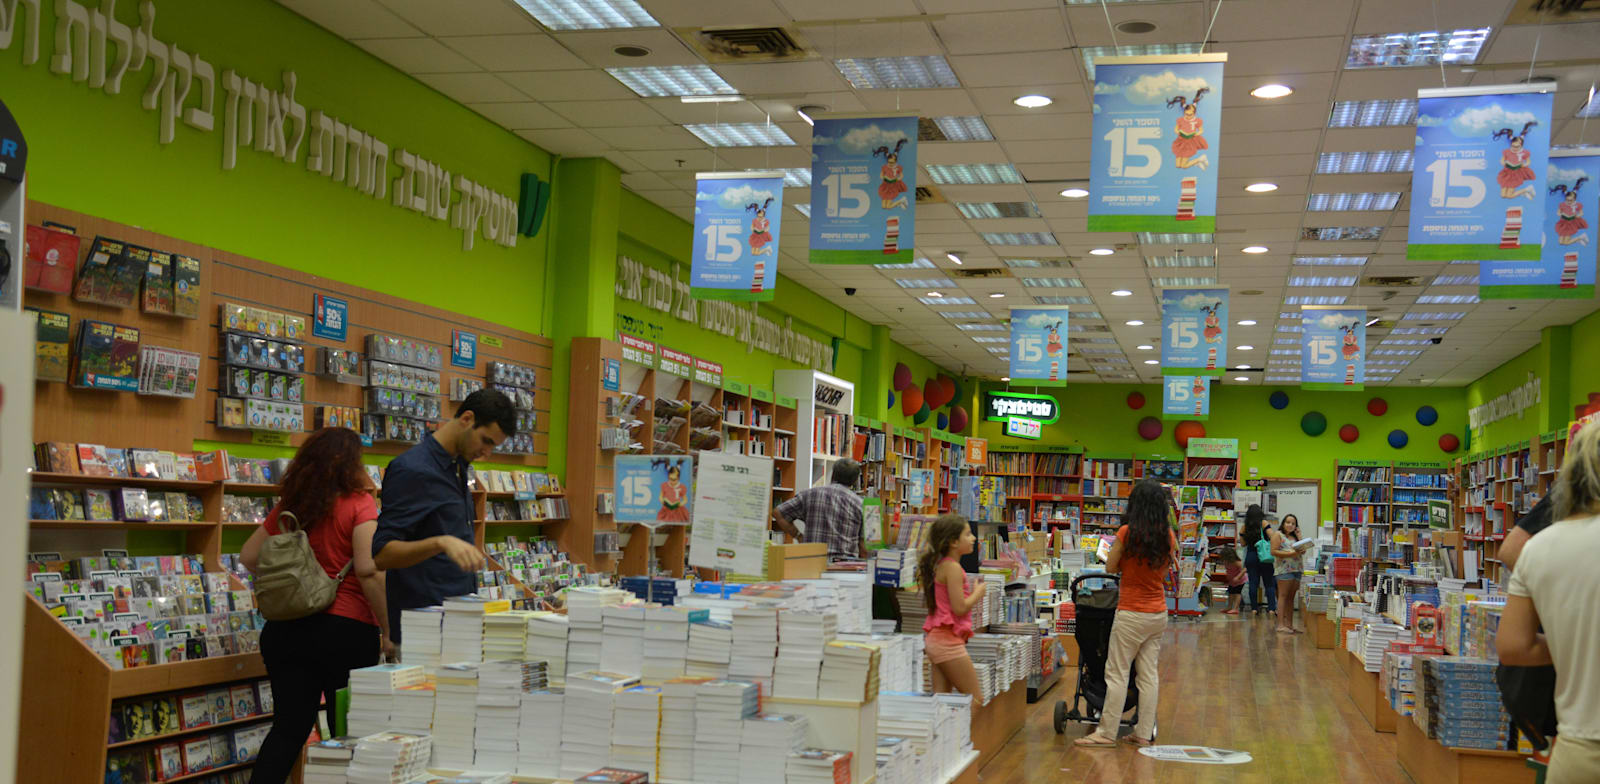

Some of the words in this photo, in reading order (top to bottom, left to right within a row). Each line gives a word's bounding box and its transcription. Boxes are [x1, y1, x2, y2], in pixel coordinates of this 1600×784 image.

[51, 0, 214, 144] בקלילות
[223, 70, 306, 169] לאוזן
[307, 110, 388, 198] חודרת
[1104, 127, 1163, 178] 15
[393, 148, 450, 220] טובה
[821, 173, 871, 218] 15
[1425, 158, 1487, 208] 15
[452, 176, 518, 251] מוסיקה
[702, 224, 743, 262] 15
[1015, 338, 1043, 362] 15
[1168, 321, 1199, 349] 15
[1307, 340, 1338, 365] 15
[992, 398, 1051, 416] סטימצקי
[1167, 382, 1190, 401] 15
[1011, 418, 1040, 435] ילדים
[721, 463, 735, 473] מכר
[621, 476, 652, 506] 15
